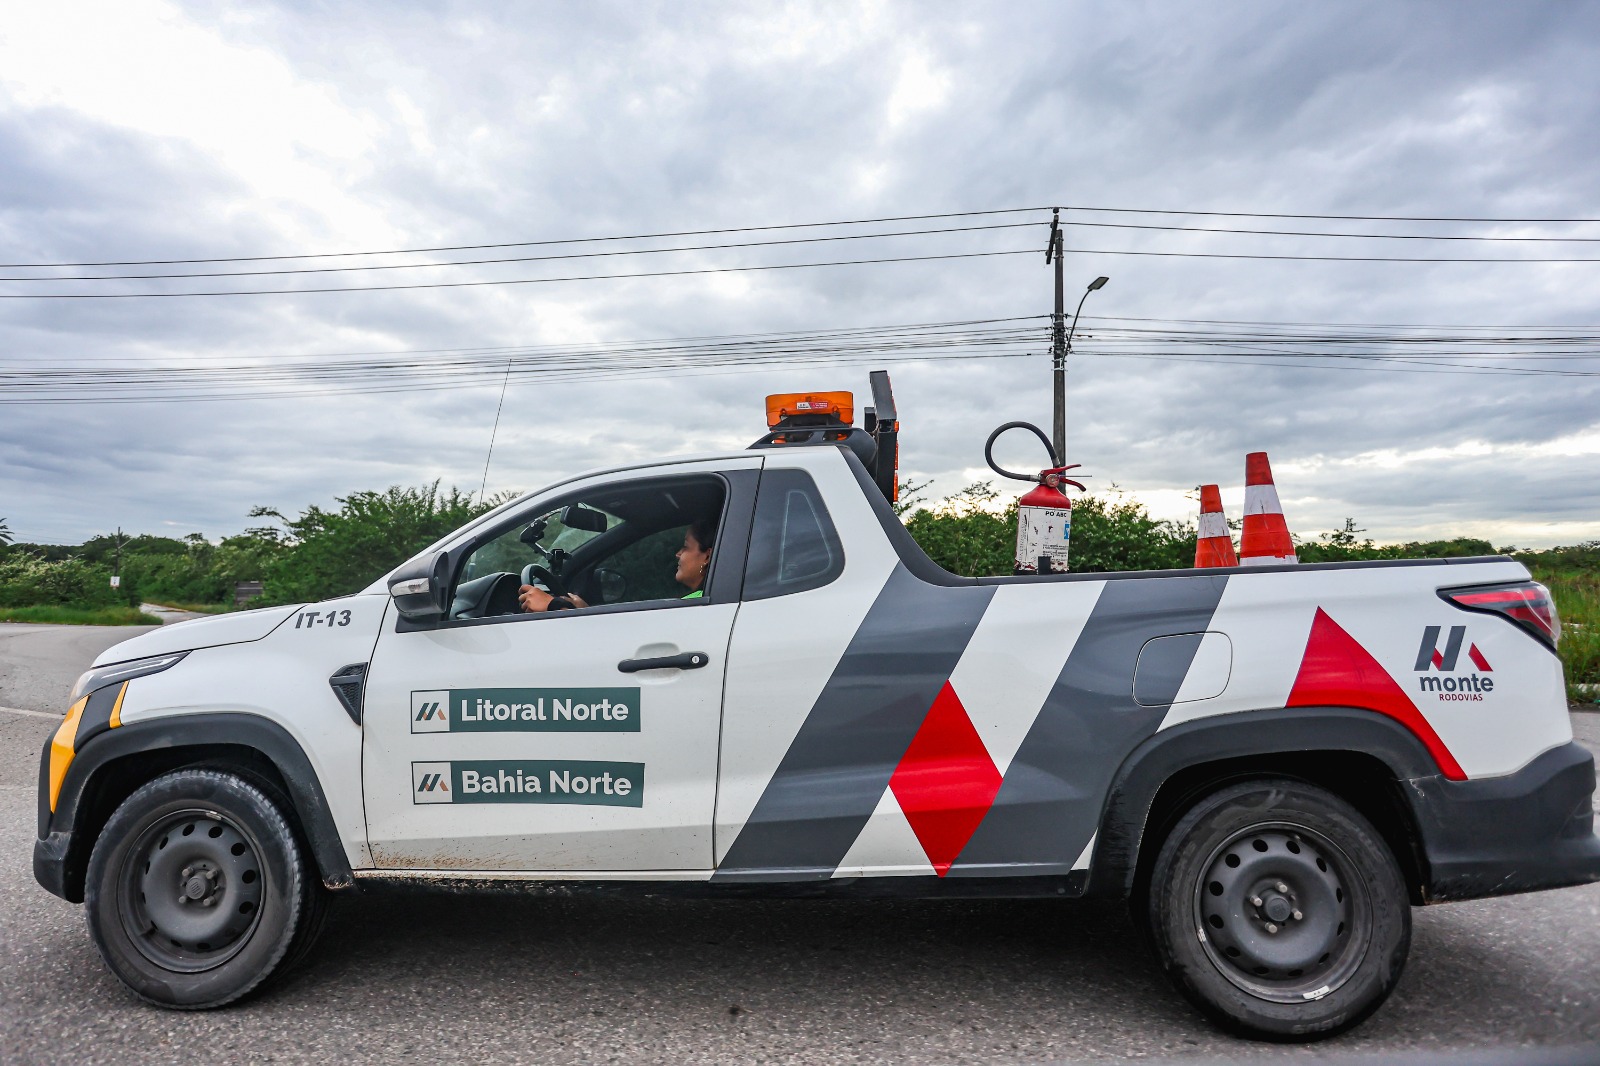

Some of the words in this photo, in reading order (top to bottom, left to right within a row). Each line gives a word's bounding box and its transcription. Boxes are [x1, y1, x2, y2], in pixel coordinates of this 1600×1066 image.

[295, 609, 352, 629] IT-13
[1419, 673, 1494, 692] monte
[1438, 693, 1483, 702] RODOVIAS
[461, 697, 547, 722] Litoral
[552, 698, 629, 721] Norte
[461, 769, 542, 794] Bahia
[549, 770, 632, 796] Norte
